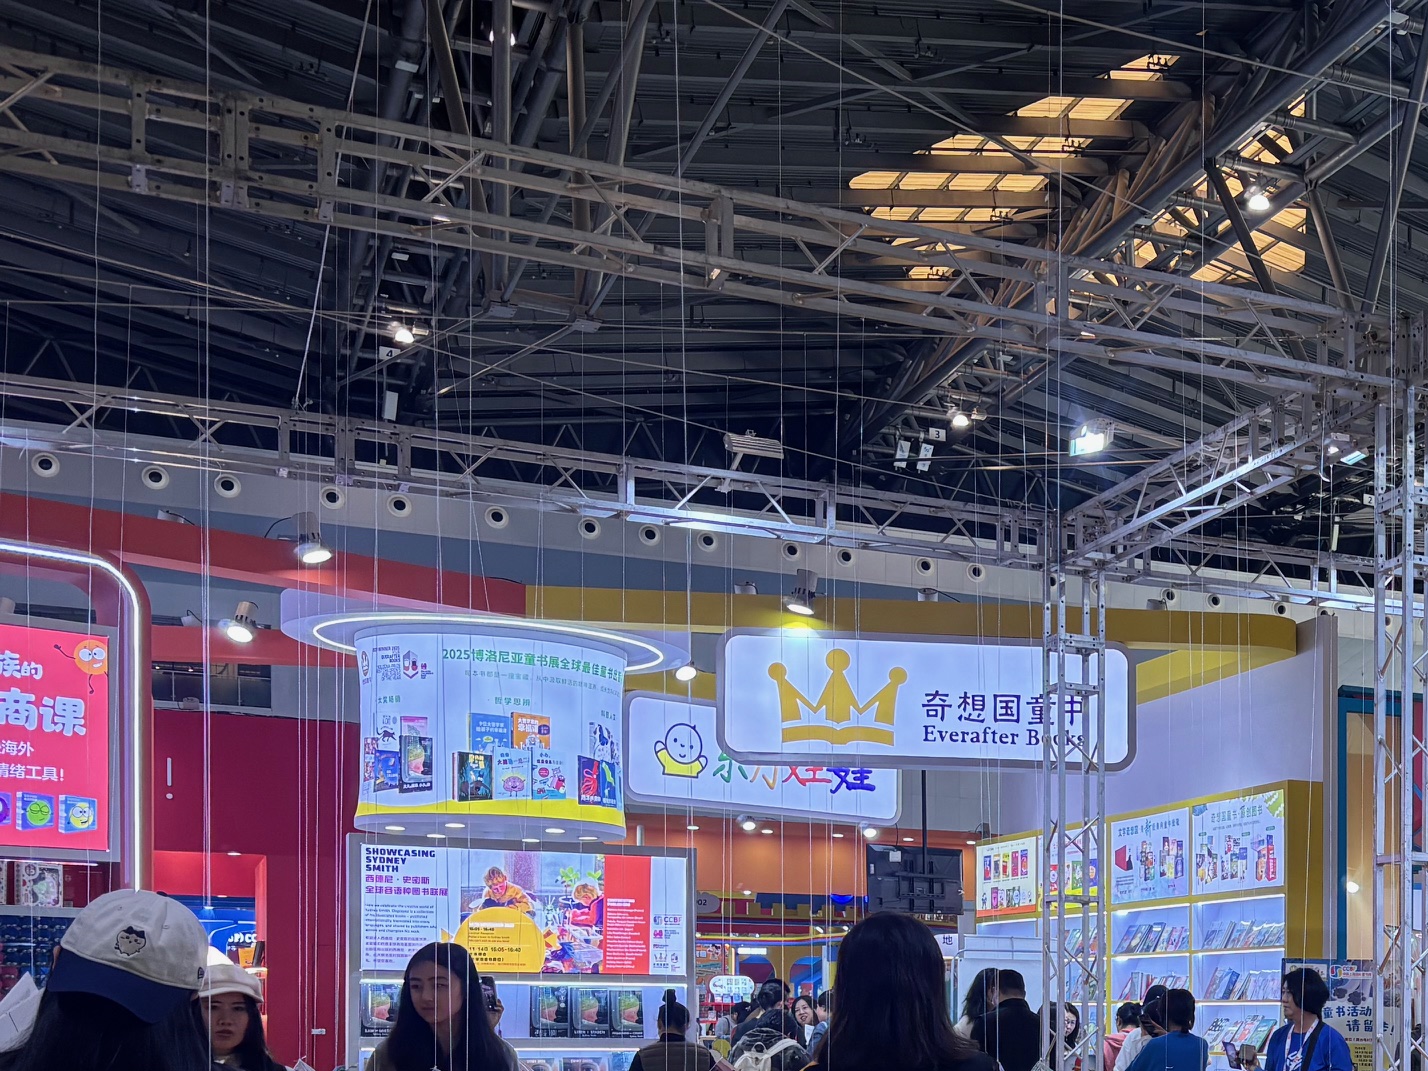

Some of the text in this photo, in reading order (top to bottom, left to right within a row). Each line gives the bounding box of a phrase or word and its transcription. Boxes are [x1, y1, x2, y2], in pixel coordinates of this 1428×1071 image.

[923, 725, 1019, 746] Everafter
[0, 740, 35, 758] 海外
[365, 847, 436, 858] SHOWCASING
[365, 856, 407, 865] SYDNEY
[365, 864, 399, 873] SMITH
